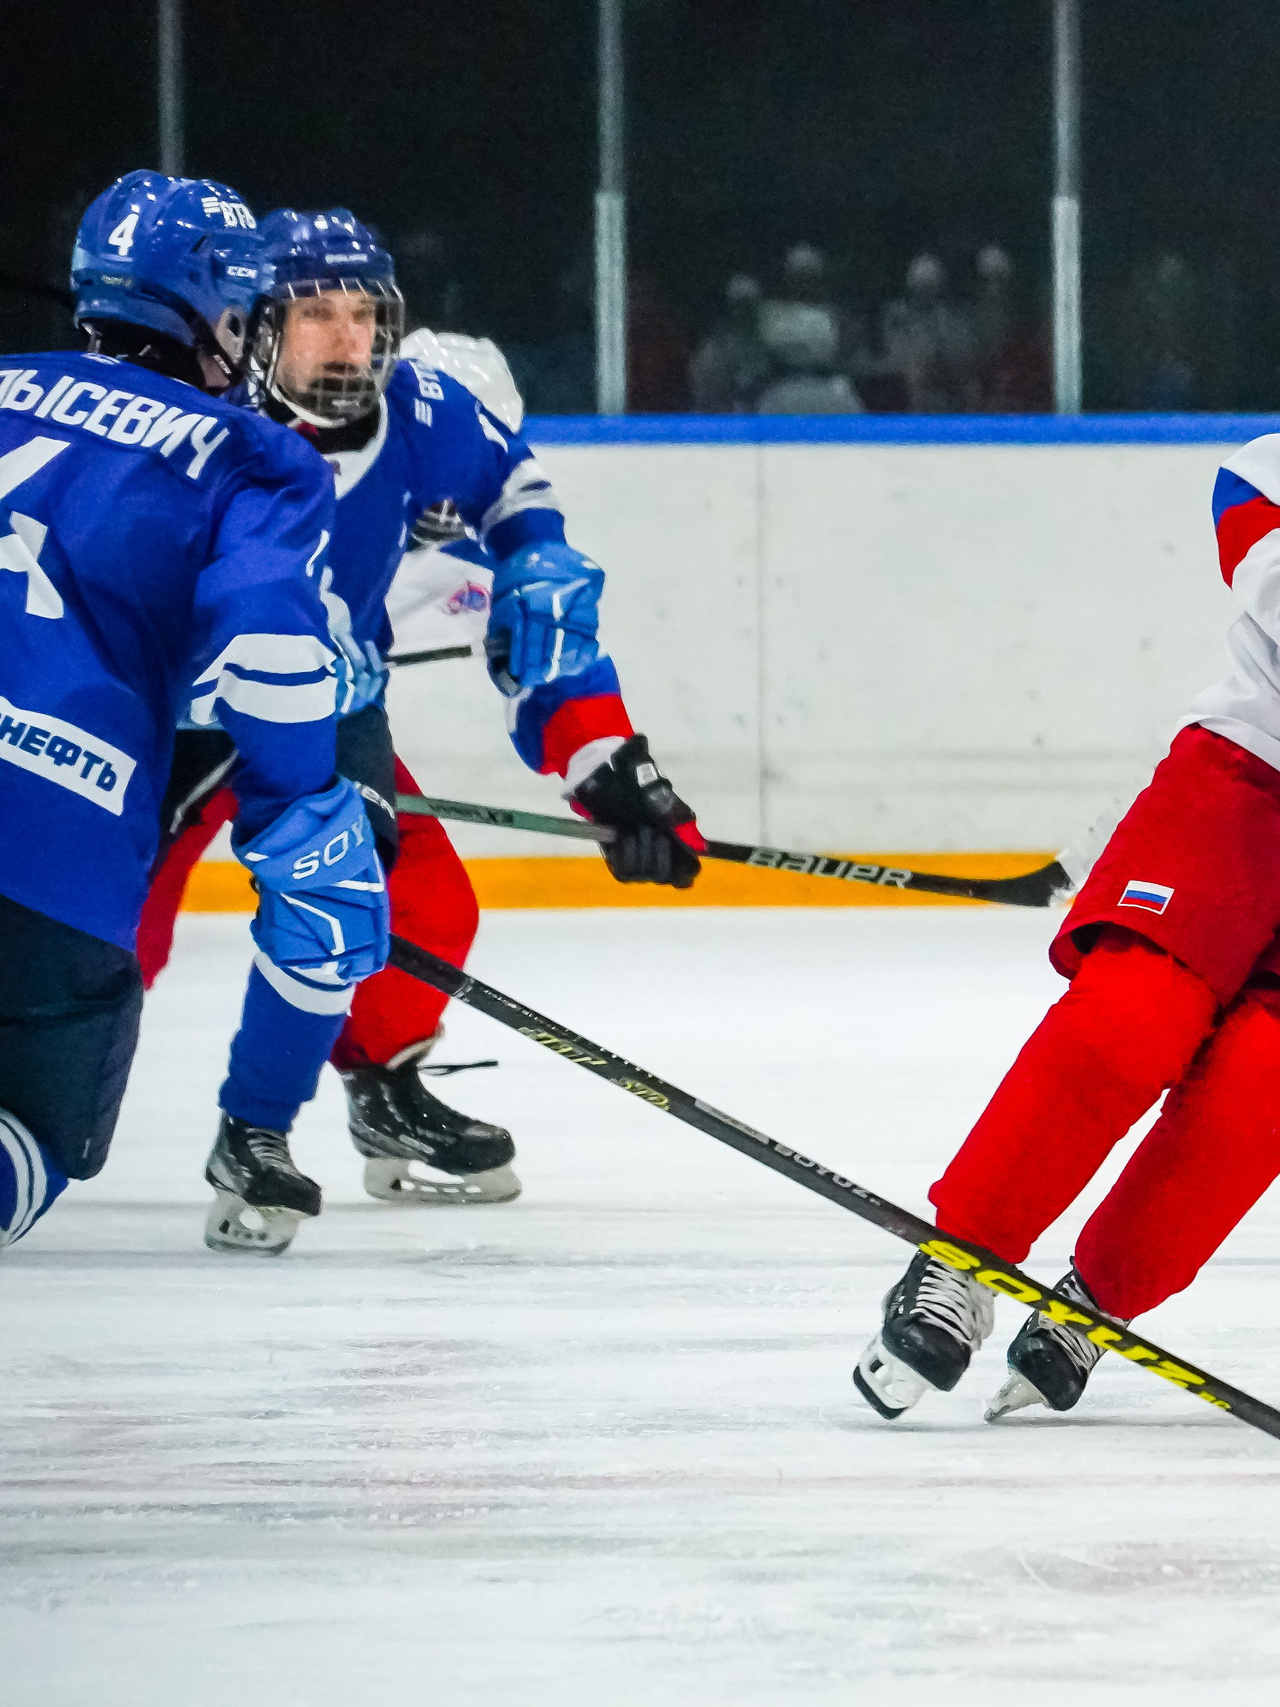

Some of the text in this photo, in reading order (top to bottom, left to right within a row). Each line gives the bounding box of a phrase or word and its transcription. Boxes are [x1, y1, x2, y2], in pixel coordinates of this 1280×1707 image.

[108, 213, 139, 256] 4
[0, 713, 117, 792] НЕФТЬ
[919, 1240, 1205, 1389] SOYUZ
